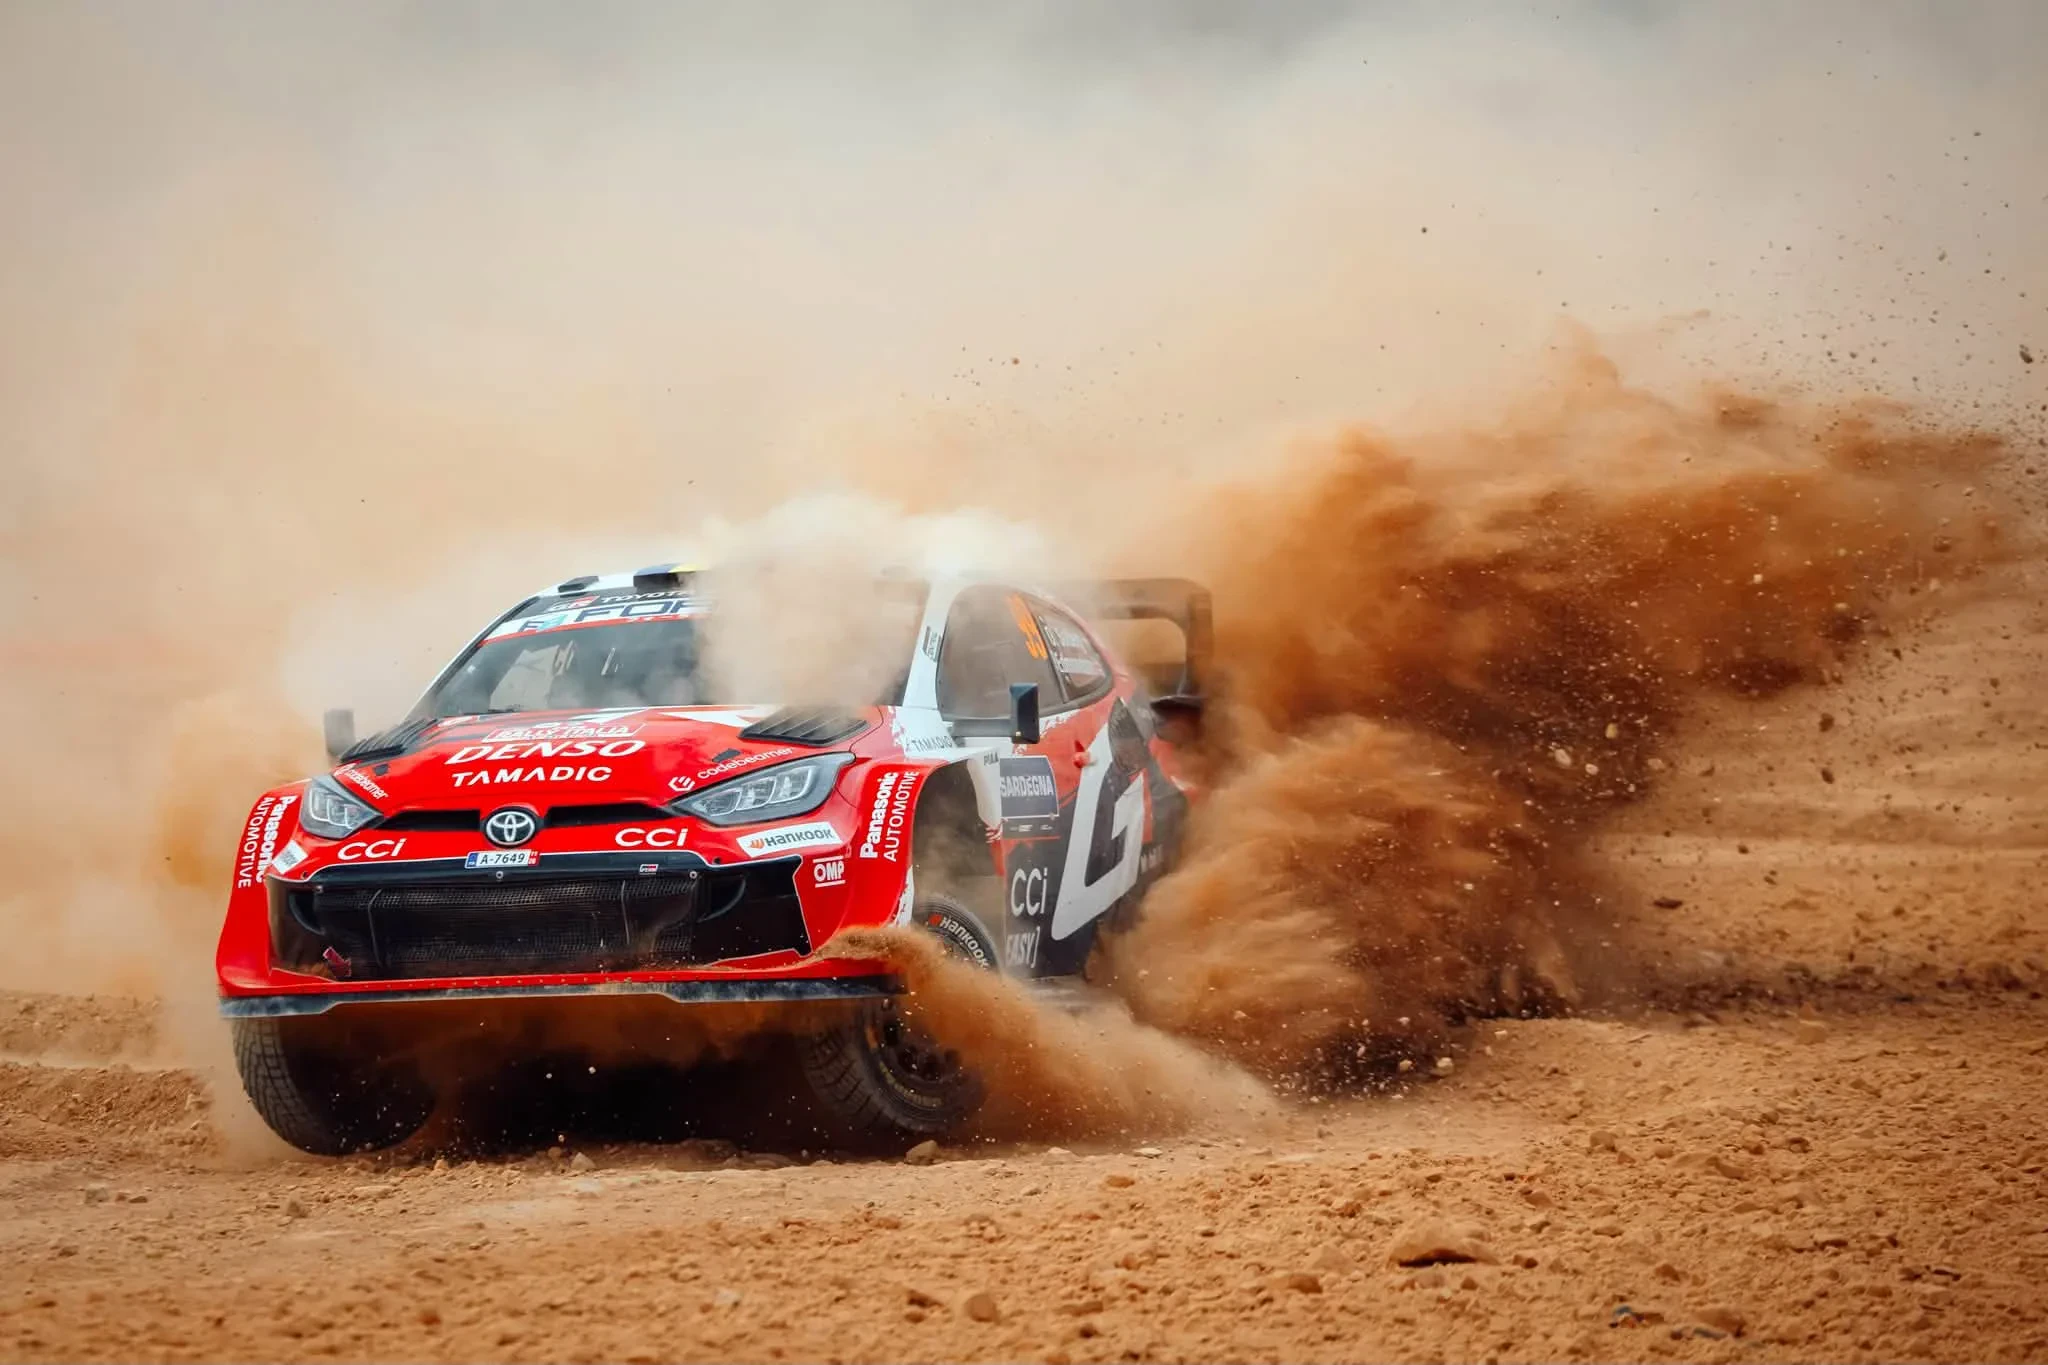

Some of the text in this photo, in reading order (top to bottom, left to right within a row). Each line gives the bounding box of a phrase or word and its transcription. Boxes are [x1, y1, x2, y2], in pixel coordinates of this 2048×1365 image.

[444, 740, 646, 765] DENSO
[697, 747, 797, 779] codebeamer
[452, 766, 613, 788] TAMADIC
[1000, 775, 1054, 798] SARDEGNA
[859, 771, 899, 859] Panasonic
[883, 771, 920, 863] AUTOMOTIVE
[238, 797, 276, 889] AUTOMOTIVE
[255, 795, 298, 884] Panasonic
[480, 853, 526, 866] A-7649
[813, 860, 845, 883] OMP
